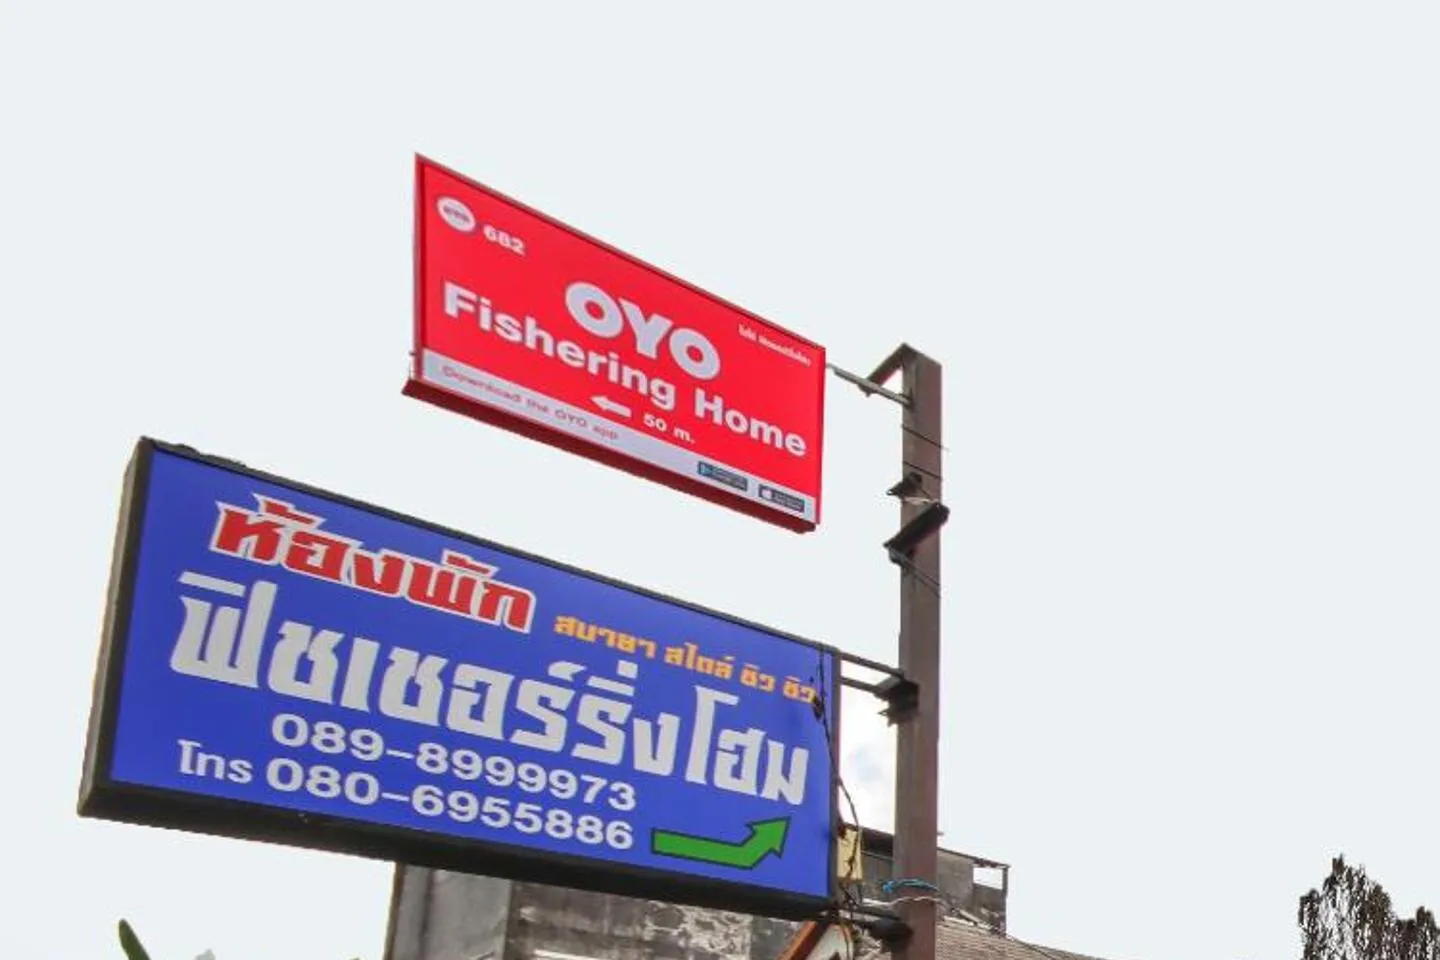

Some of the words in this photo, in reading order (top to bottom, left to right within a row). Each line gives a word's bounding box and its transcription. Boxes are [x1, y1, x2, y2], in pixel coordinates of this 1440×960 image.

[482, 224, 526, 257] 682
[443, 280, 677, 412] Fishering
[694, 388, 808, 457] Home
[565, 281, 721, 380] OYO
[554, 408, 589, 428] OYO
[643, 412, 668, 433] 50
[673, 426, 696, 445] m.
[208, 493, 538, 635] ห้องพัก
[177, 738, 254, 785] โทร
[265, 757, 634, 851] 080-6955886
[271, 712, 638, 812] 089-8999973
